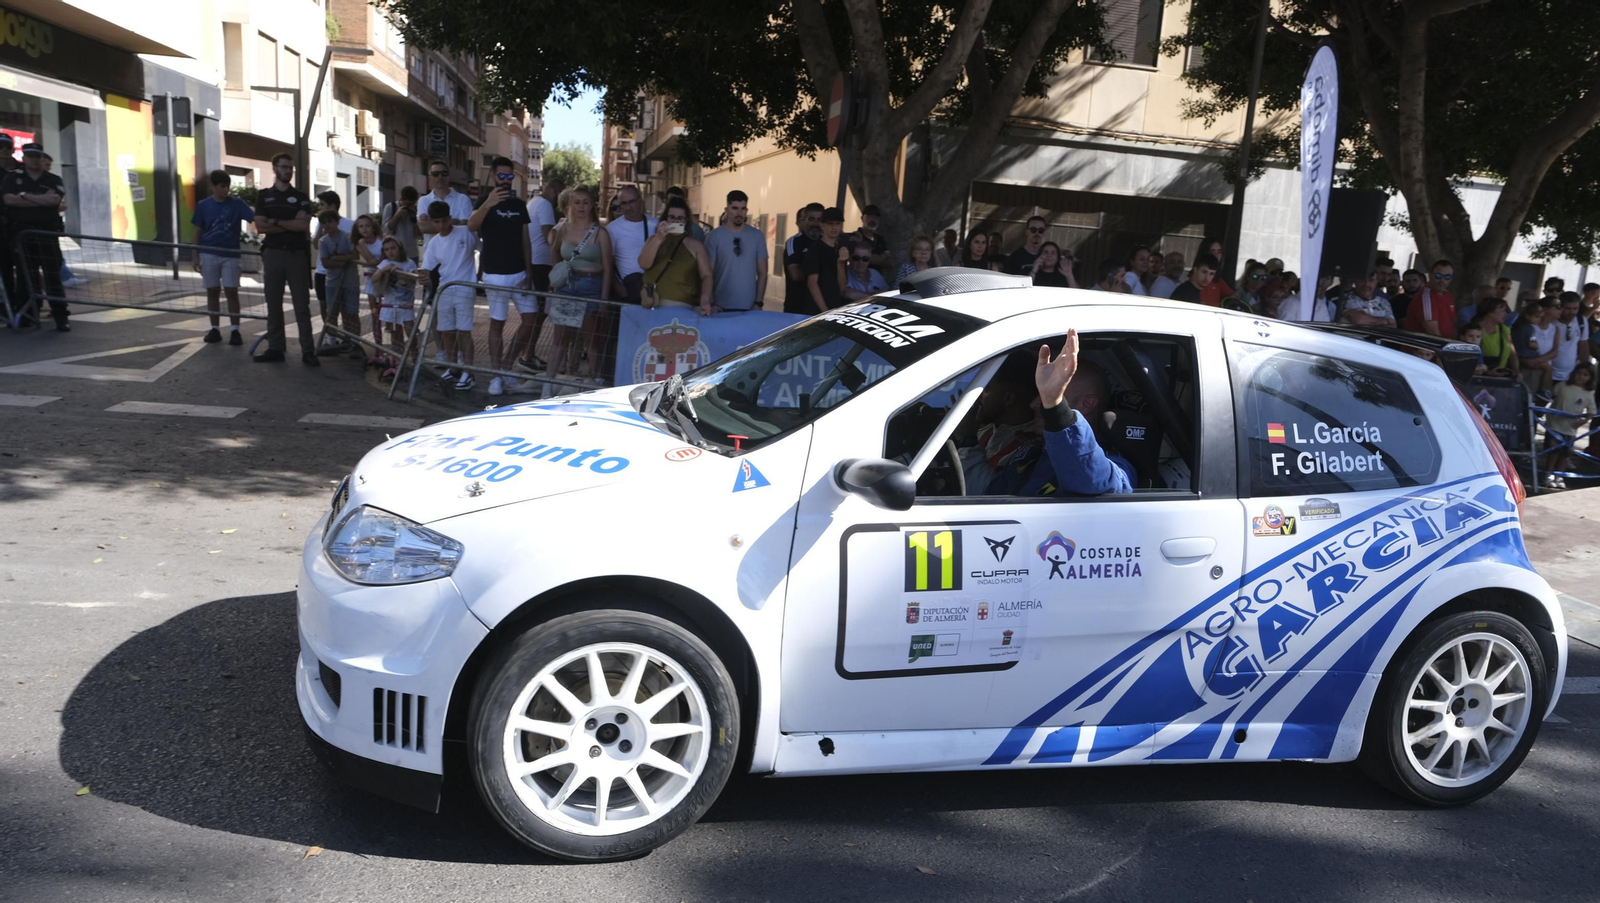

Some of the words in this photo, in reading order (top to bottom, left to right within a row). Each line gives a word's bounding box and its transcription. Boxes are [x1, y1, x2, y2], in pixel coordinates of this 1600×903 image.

[1126, 428, 1145, 437] OMP
[1292, 421, 1382, 444] L.García
[385, 433, 480, 450] Fiat
[473, 436, 630, 474] Punto
[391, 453, 523, 482] S-1600
[1271, 452, 1291, 476] F.
[1296, 450, 1384, 475] Gilabert
[1304, 507, 1335, 516] VERIFICADO
[909, 531, 953, 590] 11
[1080, 547, 1122, 559] COSTA
[1125, 546, 1141, 558] DE
[970, 568, 1029, 578] CUPRA
[1066, 558, 1142, 580] ALMERÍA
[997, 599, 1043, 611] ALMERÍA
[1203, 500, 1493, 700] GARCIA
[923, 606, 969, 615] DIPUTACIÓN
[923, 614, 933, 622] DE
[934, 613, 967, 622] ALMERÍA
